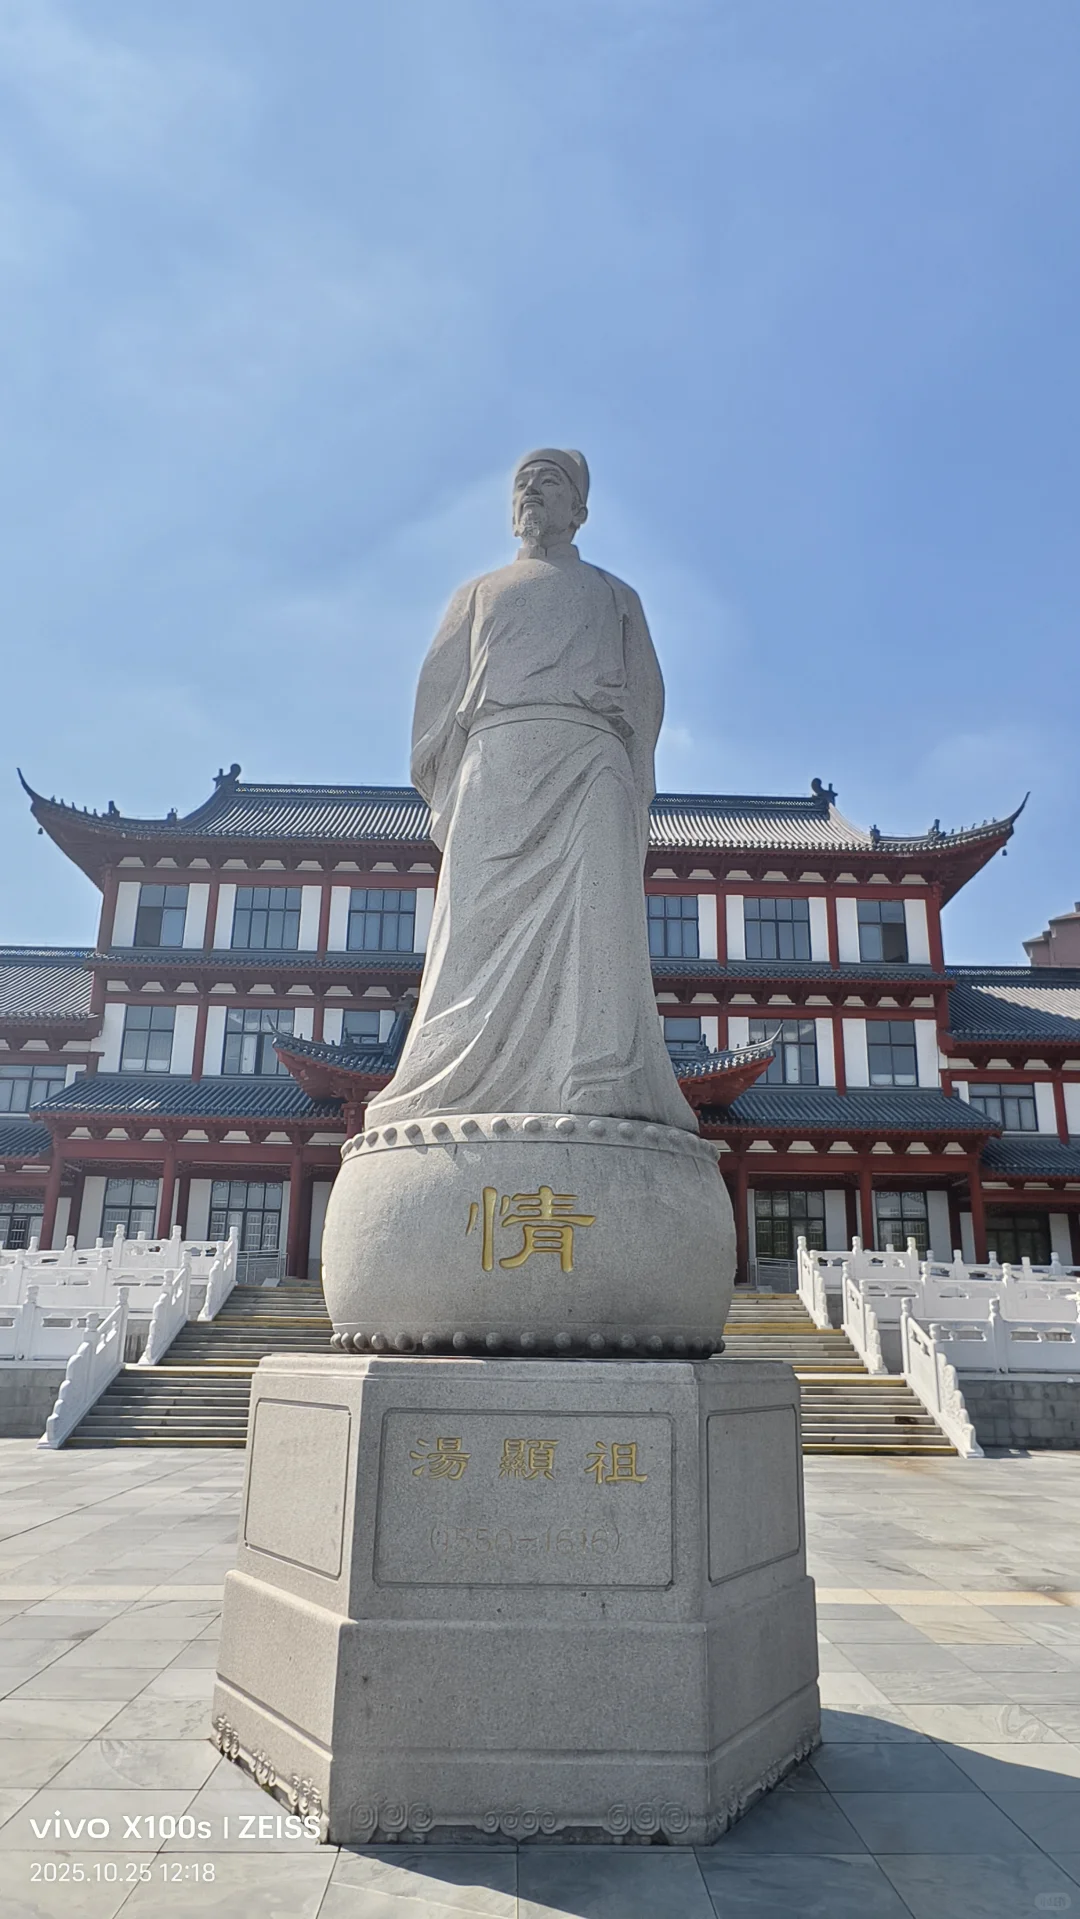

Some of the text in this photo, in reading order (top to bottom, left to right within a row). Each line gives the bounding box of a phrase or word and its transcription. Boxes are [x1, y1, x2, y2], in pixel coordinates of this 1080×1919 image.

[465, 1184, 597, 1273] 情
[409, 1436, 648, 1484] 湯顯祖
